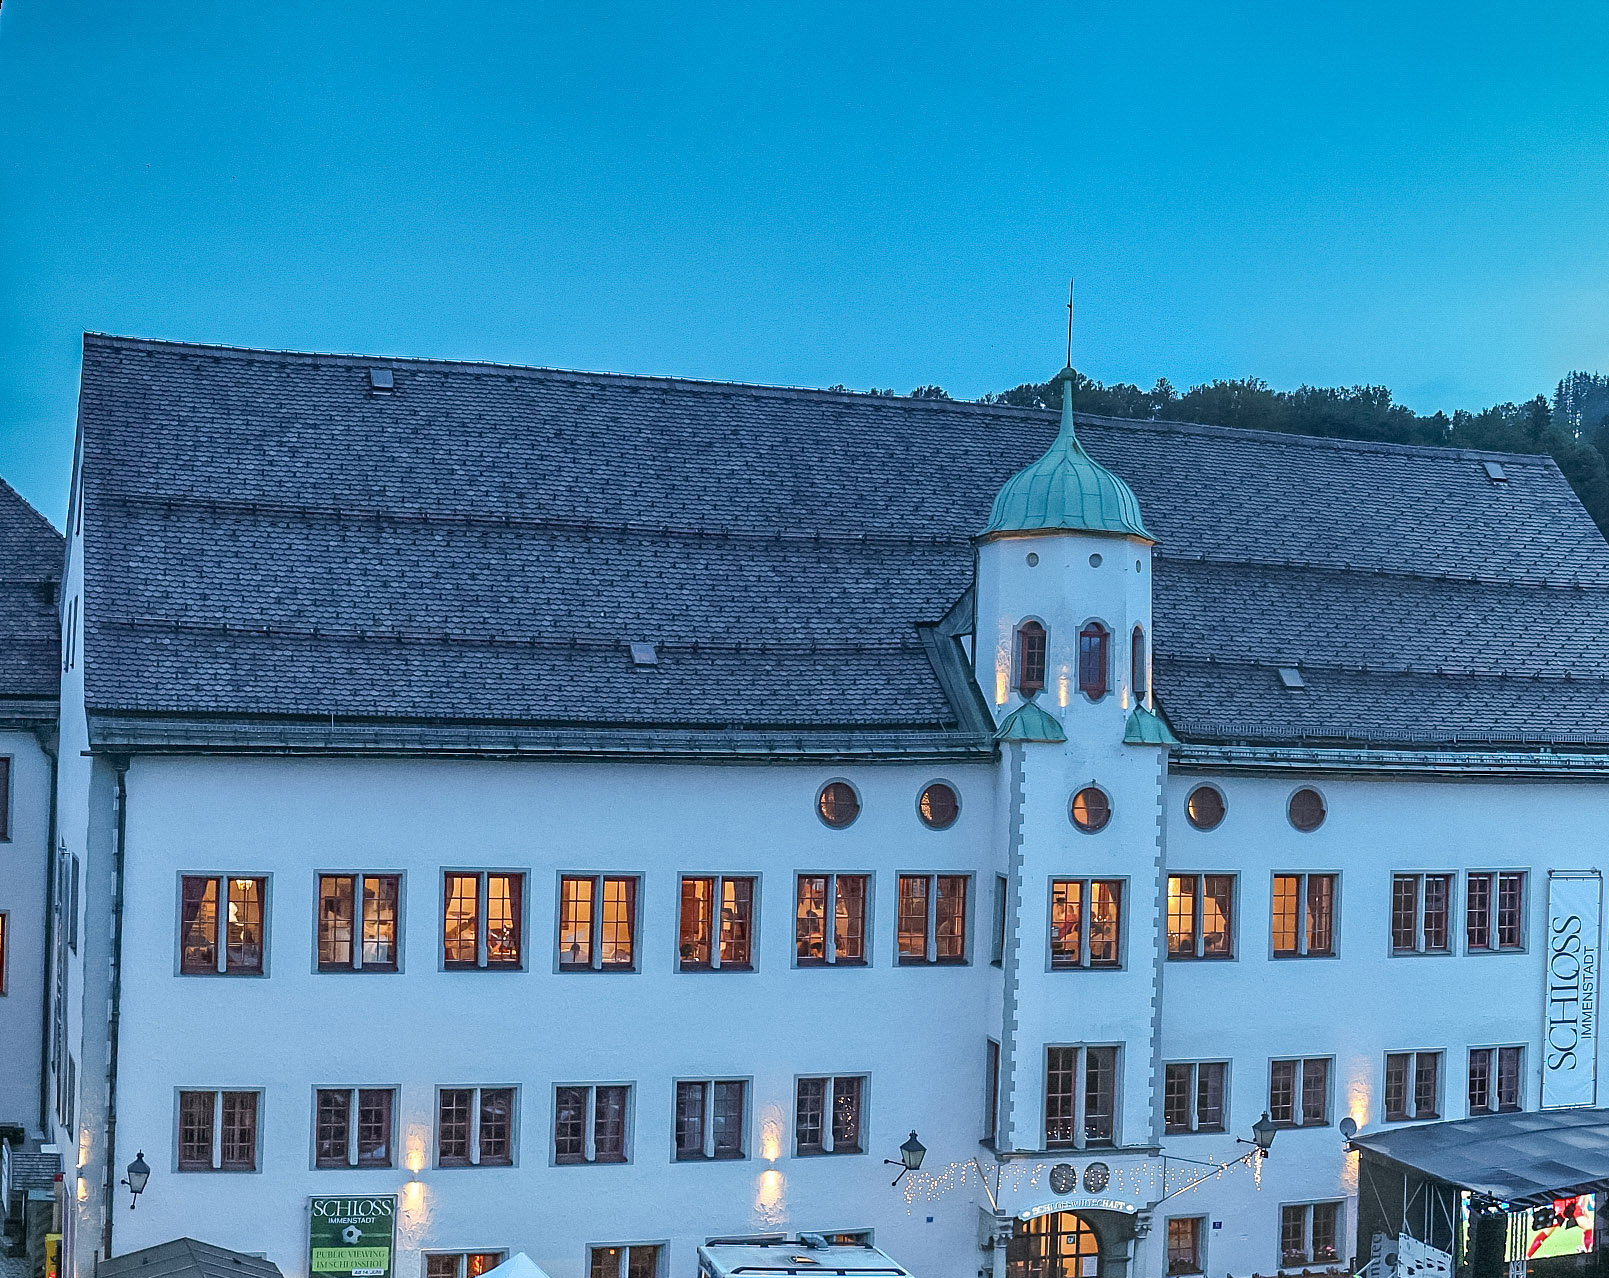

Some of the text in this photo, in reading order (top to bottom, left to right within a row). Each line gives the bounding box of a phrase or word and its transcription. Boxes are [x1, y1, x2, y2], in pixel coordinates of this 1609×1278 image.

[1547, 915, 1583, 1071] SCHLOSS
[1581, 945, 1595, 1040] IMMENSTADT
[313, 1200, 391, 1217] SCHLOSS
[316, 1250, 385, 1259] PUBLIC VIEWING
